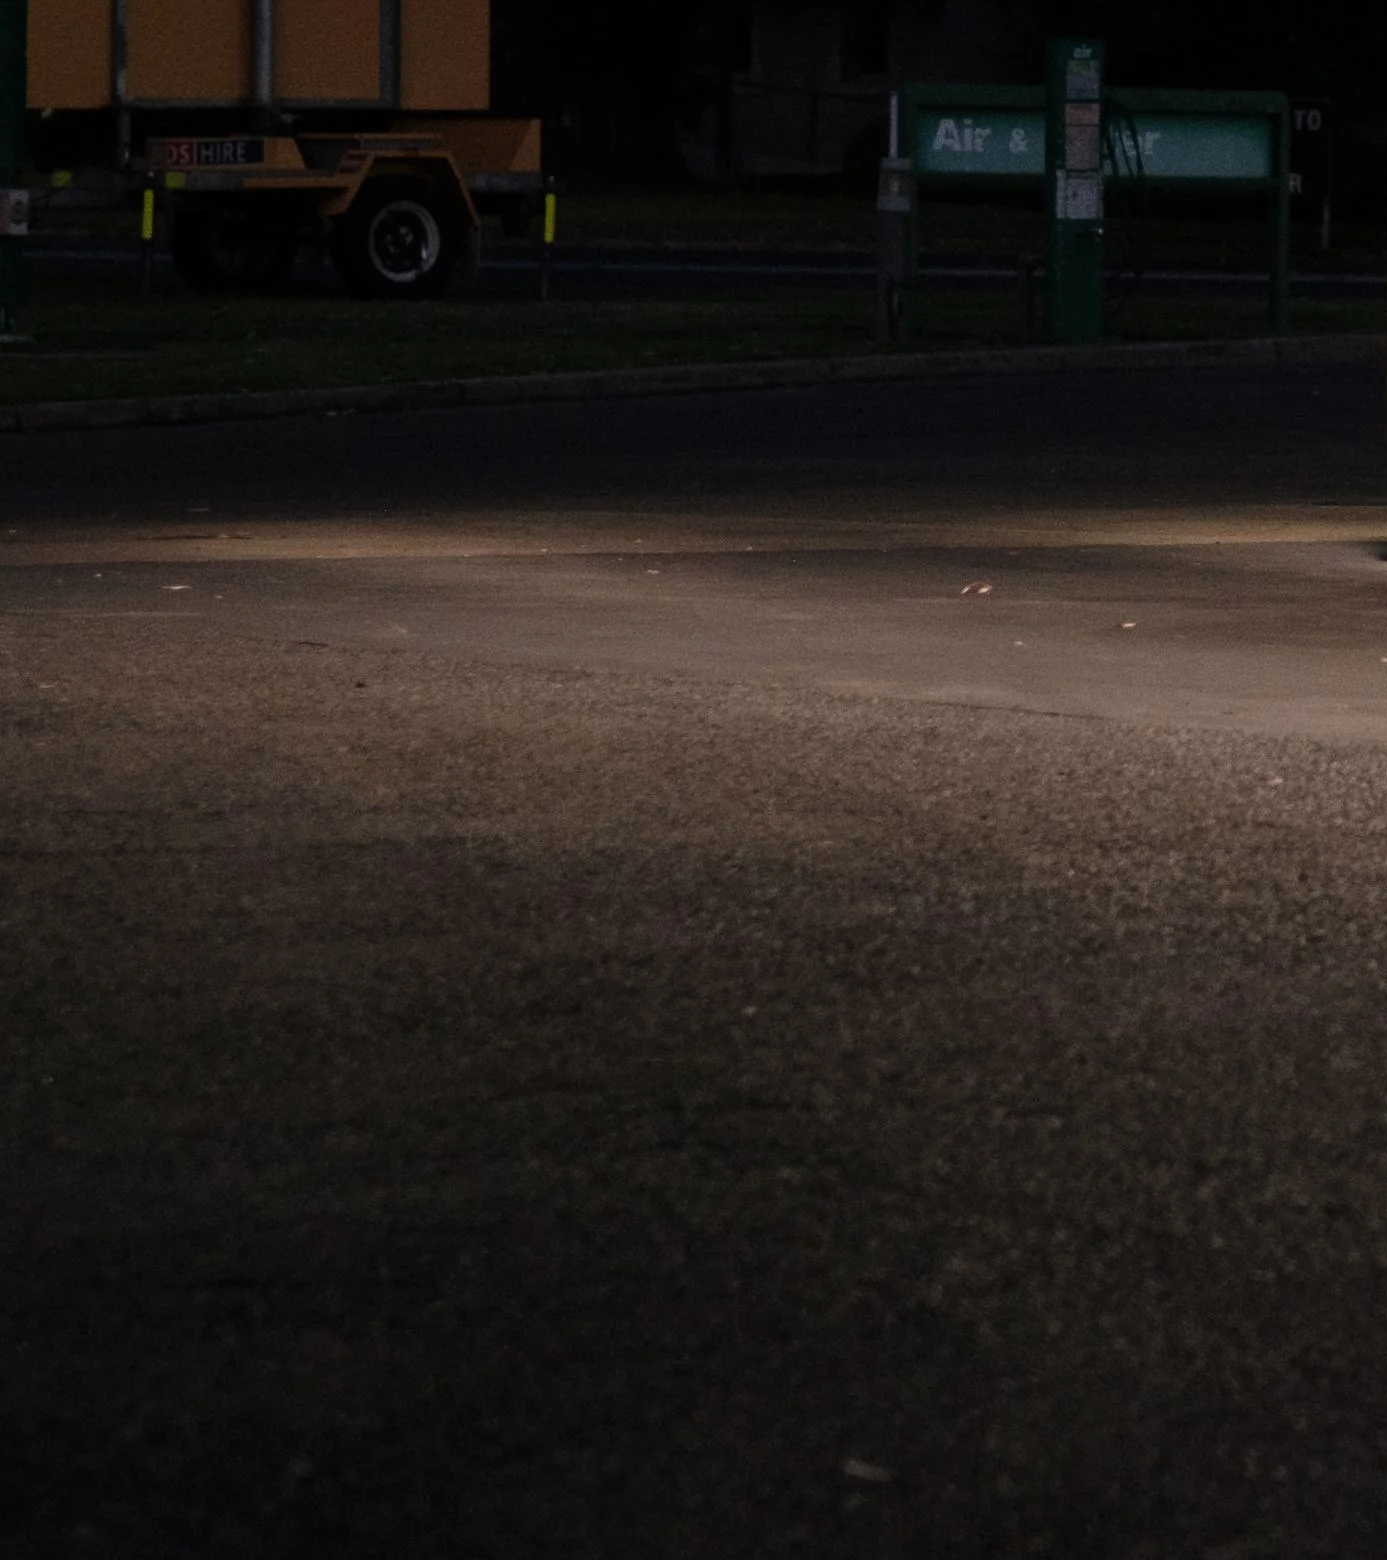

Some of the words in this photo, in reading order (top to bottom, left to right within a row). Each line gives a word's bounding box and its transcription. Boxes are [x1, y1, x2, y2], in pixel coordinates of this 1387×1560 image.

[931, 117, 992, 154] Air
[1008, 127, 1029, 154] &
[201, 141, 247, 165] HIRE
